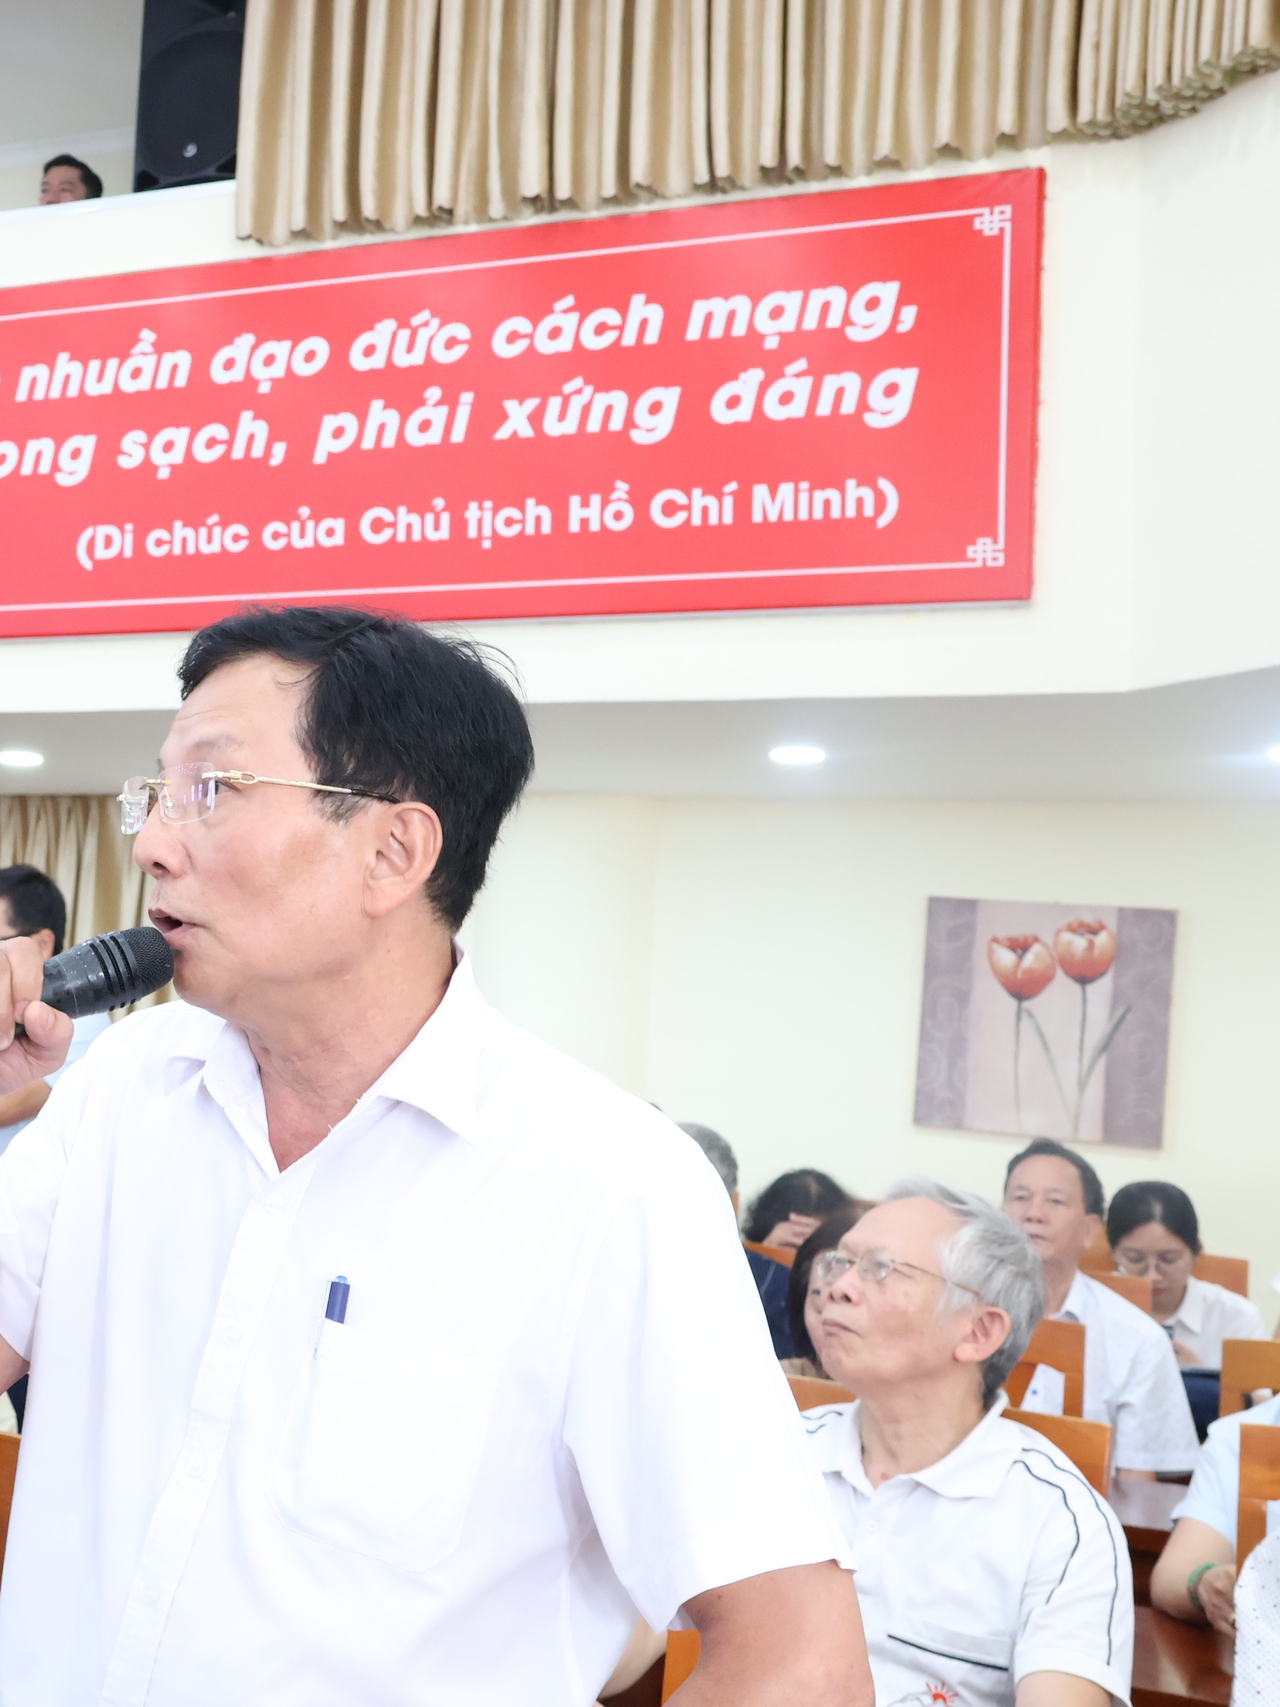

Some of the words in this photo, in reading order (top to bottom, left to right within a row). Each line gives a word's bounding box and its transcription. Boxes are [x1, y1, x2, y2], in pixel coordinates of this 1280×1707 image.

[14, 327, 193, 403] nhuần
[209, 332, 331, 394] đạo
[348, 308, 472, 372] đức
[491, 294, 664, 359] cách
[685, 280, 919, 350] mạng,
[116, 410, 289, 480] sạch,
[312, 385, 475, 465] phải
[493, 374, 682, 446] xứng
[709, 357, 920, 429] đáng
[76, 523, 134, 571] (Di
[145, 513, 250, 558] chúc
[261, 505, 346, 551] của
[359, 497, 451, 545] Chủ
[464, 500, 552, 550] tịch
[568, 480, 636, 534] Hồ
[650, 481, 740, 529] Chí
[751, 476, 901, 530] Minh)
